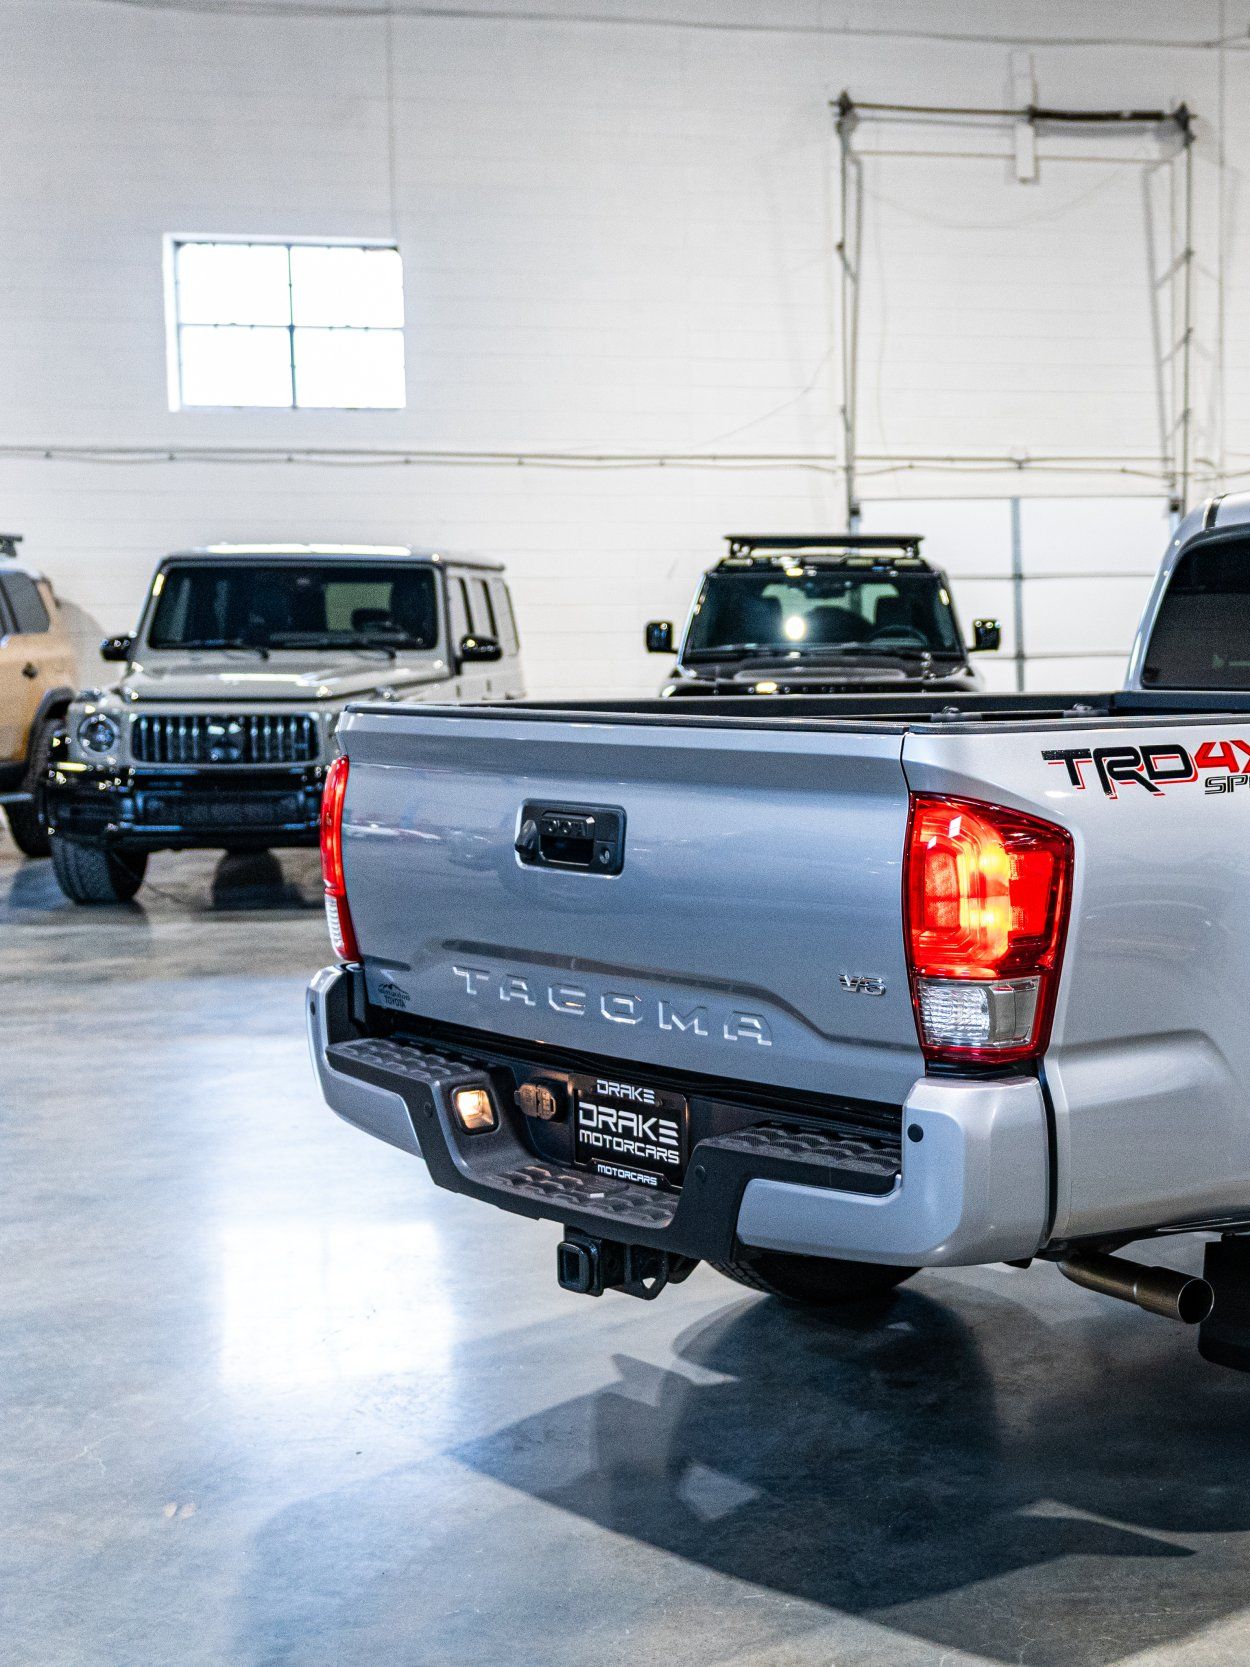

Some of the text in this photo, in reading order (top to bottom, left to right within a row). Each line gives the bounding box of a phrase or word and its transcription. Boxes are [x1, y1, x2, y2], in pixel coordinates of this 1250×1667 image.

[1041, 744, 1198, 800] TRD
[838, 973, 886, 996] V6
[452, 965, 773, 1046] TACOMA
[596, 1079, 656, 1105] DRAKE
[578, 1101, 679, 1146] DRAKE
[579, 1129, 680, 1165] MOTORCARS
[597, 1164, 658, 1186] MOTORCARS
